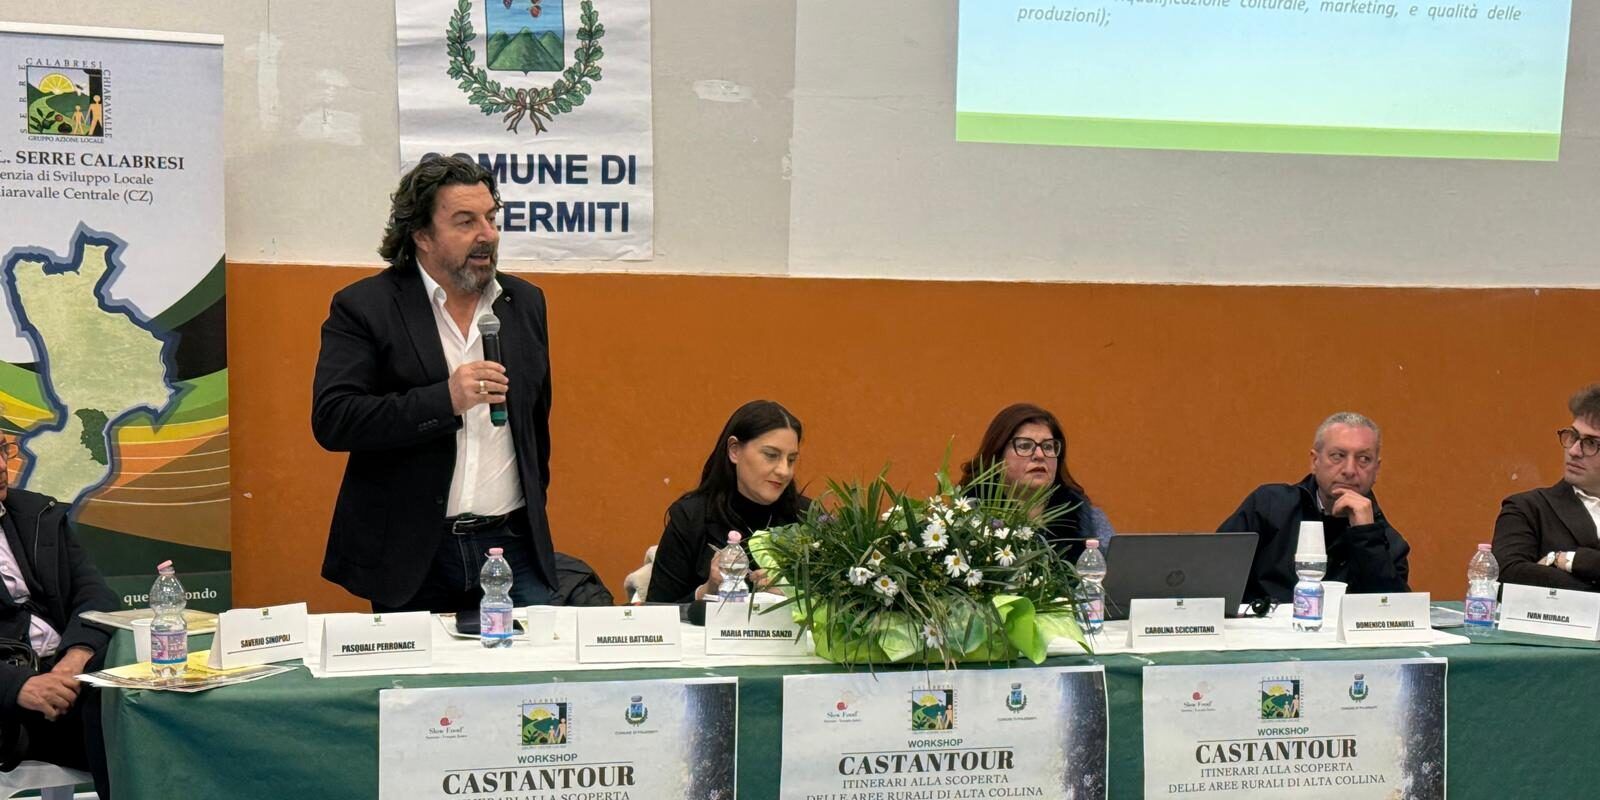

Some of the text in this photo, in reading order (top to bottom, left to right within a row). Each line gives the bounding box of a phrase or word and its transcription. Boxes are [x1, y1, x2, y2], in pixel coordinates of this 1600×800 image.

[1017, 7, 1111, 26] produzioni);
[1240, 0, 1309, 13] colturale,
[1320, 1, 1398, 18] marketing,
[1409, 7, 1418, 16] e
[1427, 4, 1478, 20] qualità
[1487, 7, 1522, 20] delle
[26, 58, 102, 68] CALABRESI
[103, 69, 113, 139] CHIARAVALLE
[16, 150, 76, 166] SERRE
[80, 152, 185, 170] CALABRESI
[420, 152, 636, 185] MUNE DI
[37, 170, 50, 181] di
[53, 171, 110, 186] Sviluppo
[114, 174, 154, 185] Locale
[0, 186, 154, 205] iaravalle Centrale (CZ)
[497, 202, 629, 232] ERMITI
[185, 588, 217, 600] ondo
[1355, 620, 1415, 629] DOMENICO EMANUELE
[1527, 612, 1570, 623] IVAN MURACA
[720, 629, 742, 638] MARIA
[742, 629, 771, 638] PATRIZIA
[1145, 626, 1174, 634] CAROLINA
[240, 633, 291, 648] SAVERIO SINOPOLI
[341, 641, 416, 653] PASQUALE PERRONACE
[597, 635, 664, 644] MARZIALE BATTAGLIA
[1257, 727, 1309, 736] WORKSHOP
[907, 738, 963, 748] WORKSHOP
[517, 753, 578, 764] WORKSHOP
[1195, 738, 1358, 764] CASTANTOUR
[838, 750, 1015, 776] CASTANTOUR
[1200, 762, 1353, 778] ITINERARI ALLA SCOPERTA
[442, 765, 636, 795] CASTANTOUR
[843, 774, 1009, 789] ITINERARI ALLA SCOPERTA
[1168, 774, 1386, 794] DELLE AREE RURALI DI ALTA COLLINA
[890, 790, 933, 800] RURALI
[937, 789, 951, 799] DI
[953, 788, 985, 798] ALTA
[988, 786, 1043, 798] COLLINA
